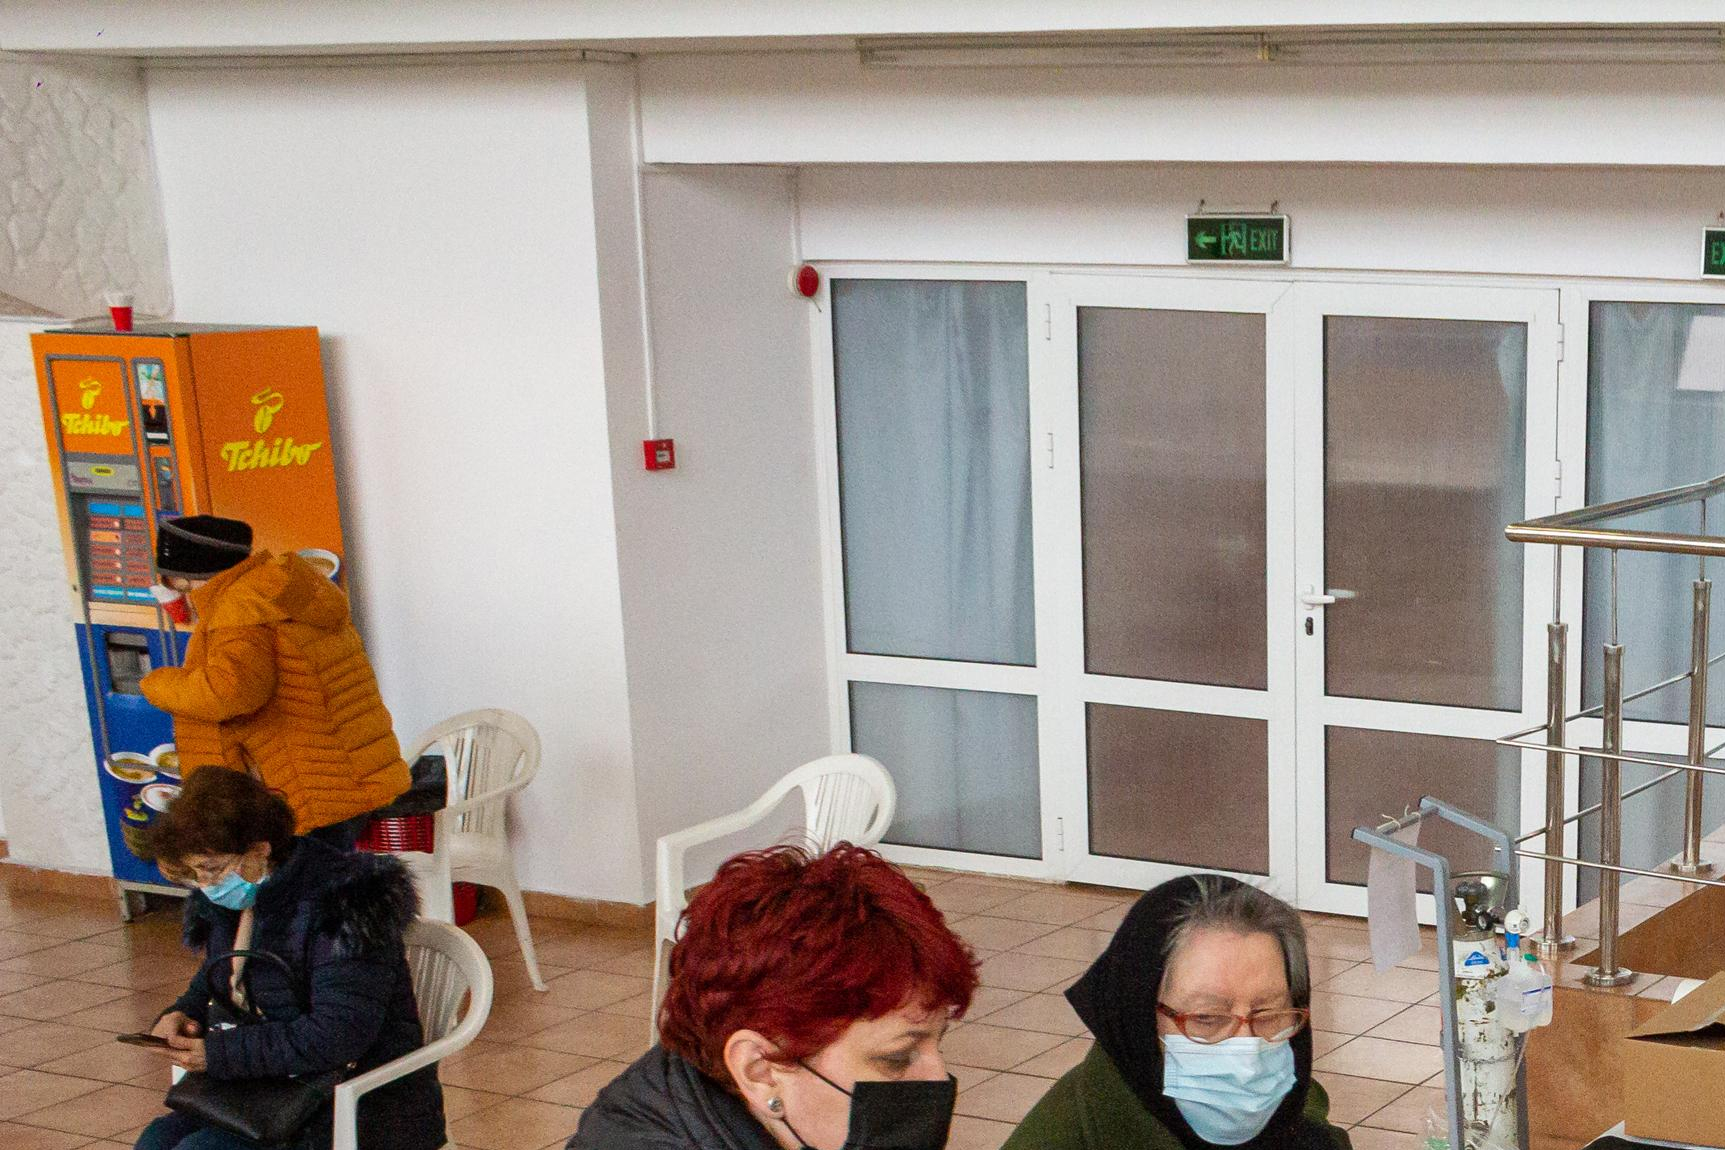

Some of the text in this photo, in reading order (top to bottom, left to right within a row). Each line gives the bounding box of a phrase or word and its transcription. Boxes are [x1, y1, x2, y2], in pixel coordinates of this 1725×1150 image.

[1250, 228, 1279, 252] EXIT
[61, 413, 129, 436] Tchibo
[221, 437, 322, 472] Tchibo
